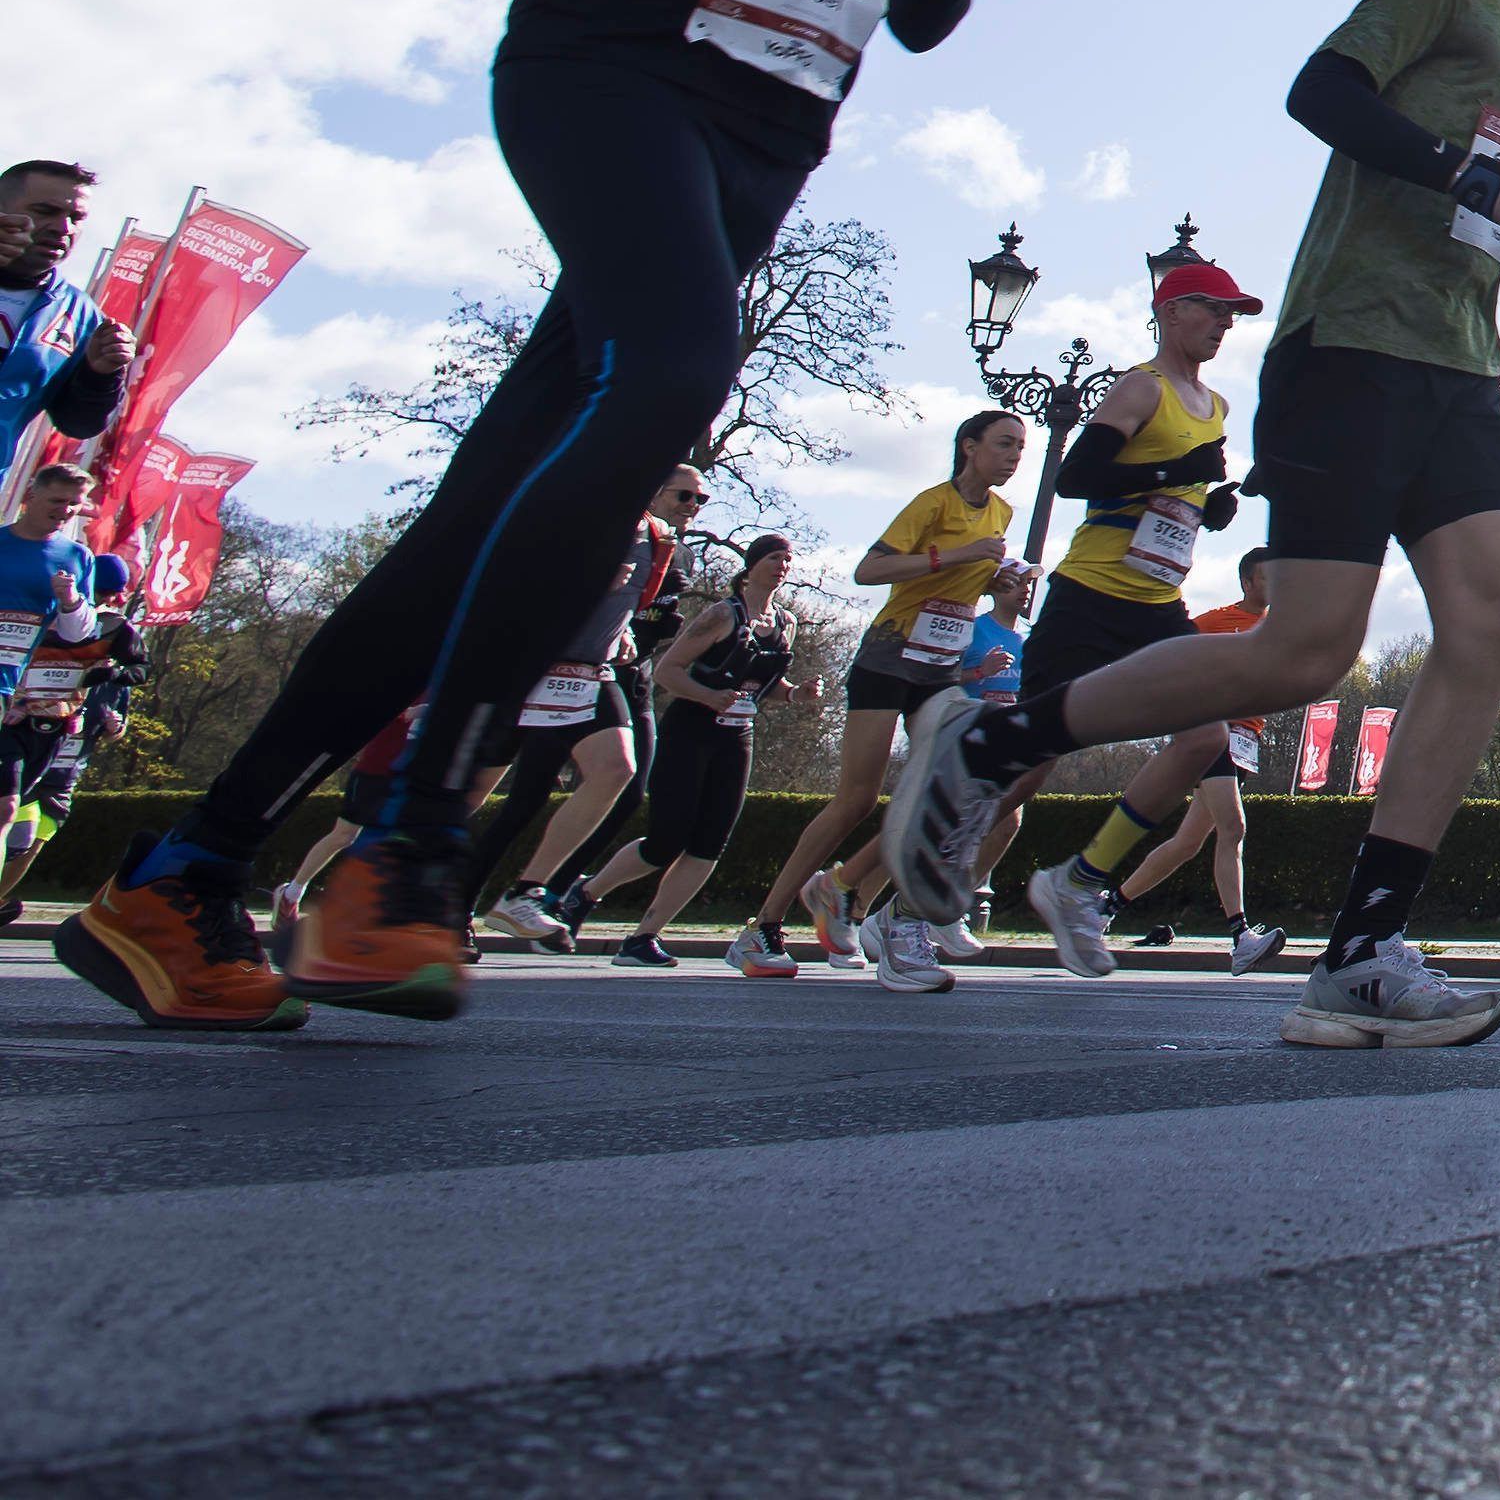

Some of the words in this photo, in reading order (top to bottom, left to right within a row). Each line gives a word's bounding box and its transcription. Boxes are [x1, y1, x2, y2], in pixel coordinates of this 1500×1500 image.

[183, 226, 247, 259] BERLINER
[211, 222, 266, 253] GENERALI
[930, 616, 965, 634] 58211
